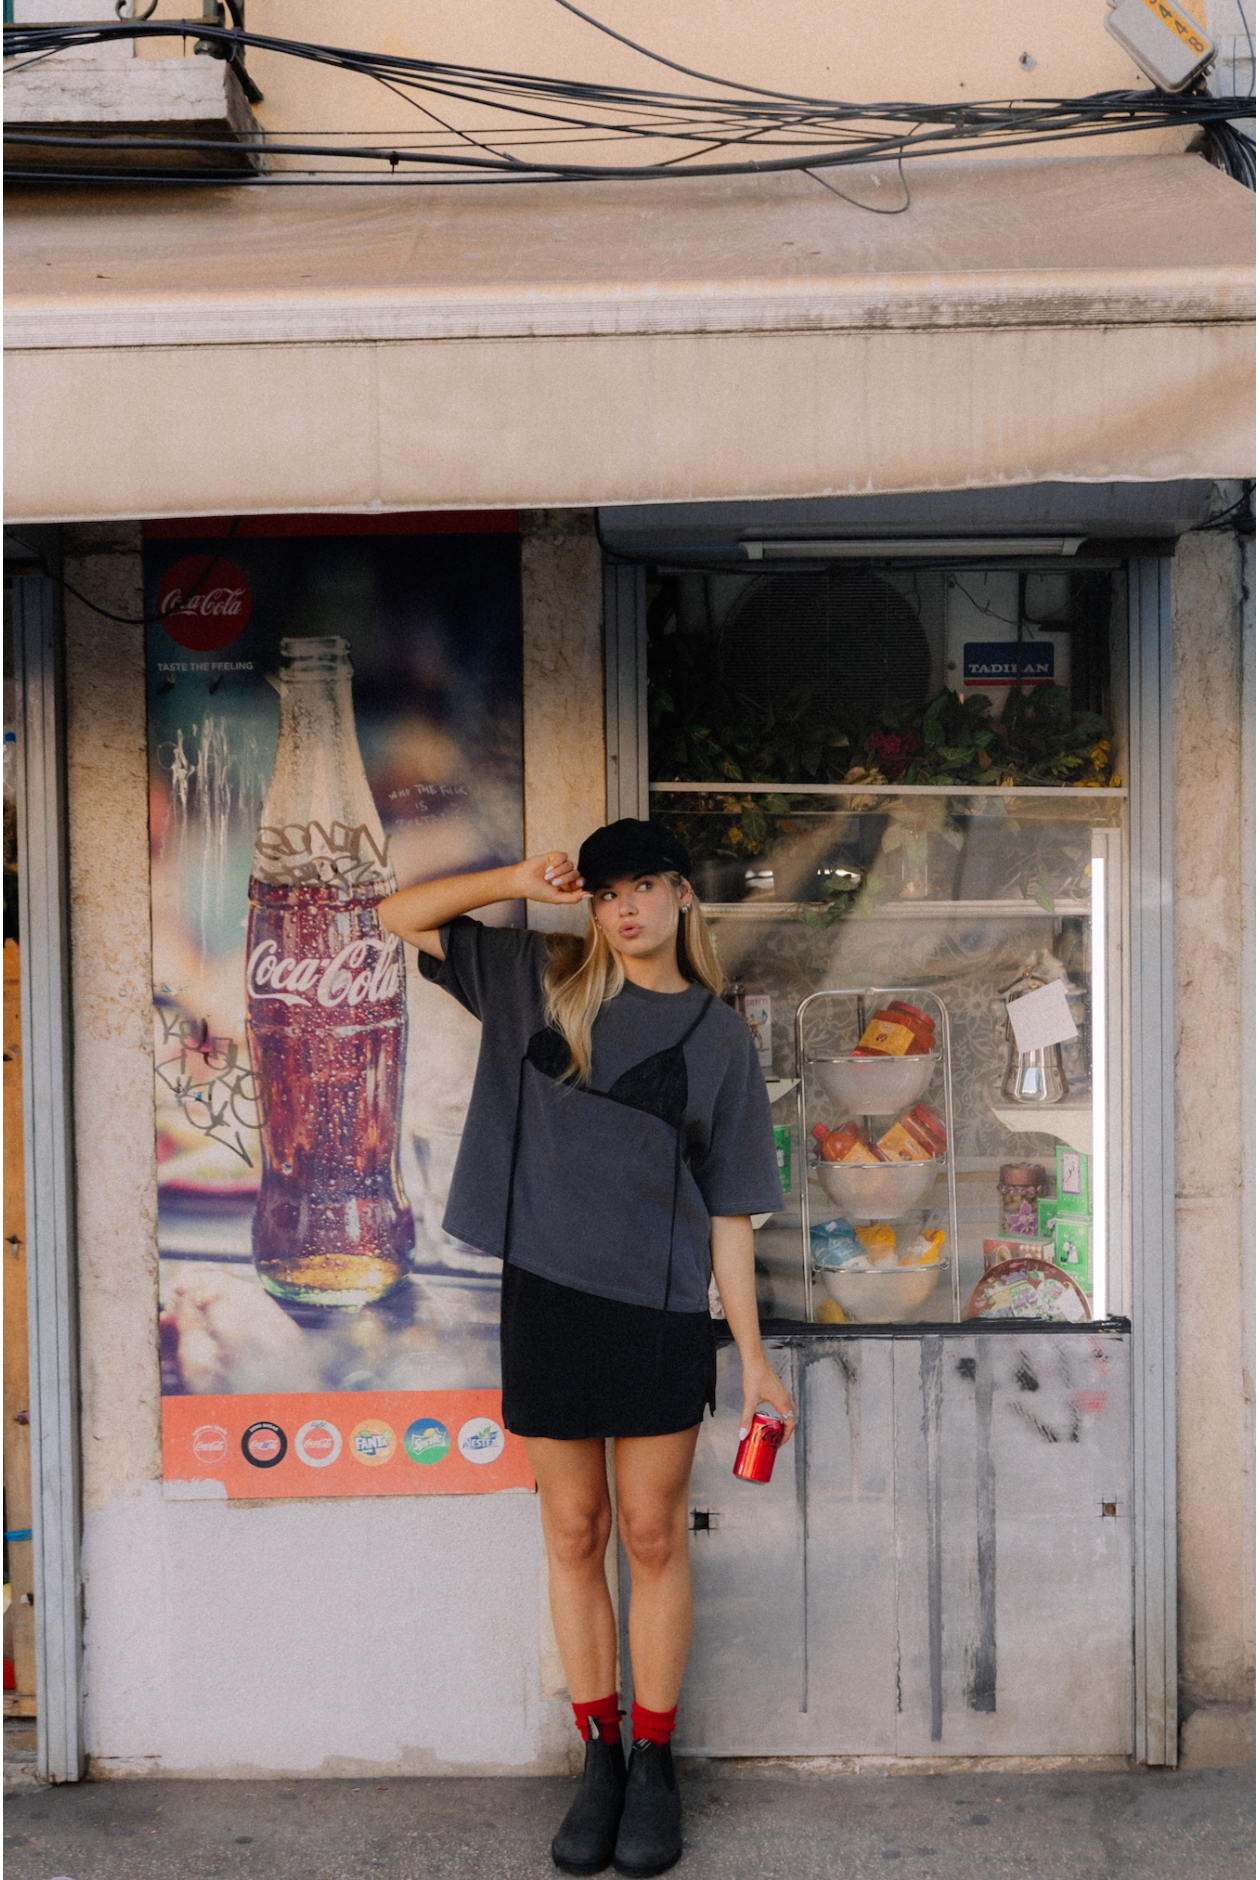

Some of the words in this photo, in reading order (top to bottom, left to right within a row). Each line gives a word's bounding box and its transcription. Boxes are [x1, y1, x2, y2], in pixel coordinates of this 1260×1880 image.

[161, 588, 246, 616] Coa-Cola
[157, 662, 188, 672] TASTE
[190, 662, 210, 671] THE
[211, 661, 254, 671] FEELING
[414, 783, 438, 796] THE
[247, 932, 400, 1008] Coca-Cola
